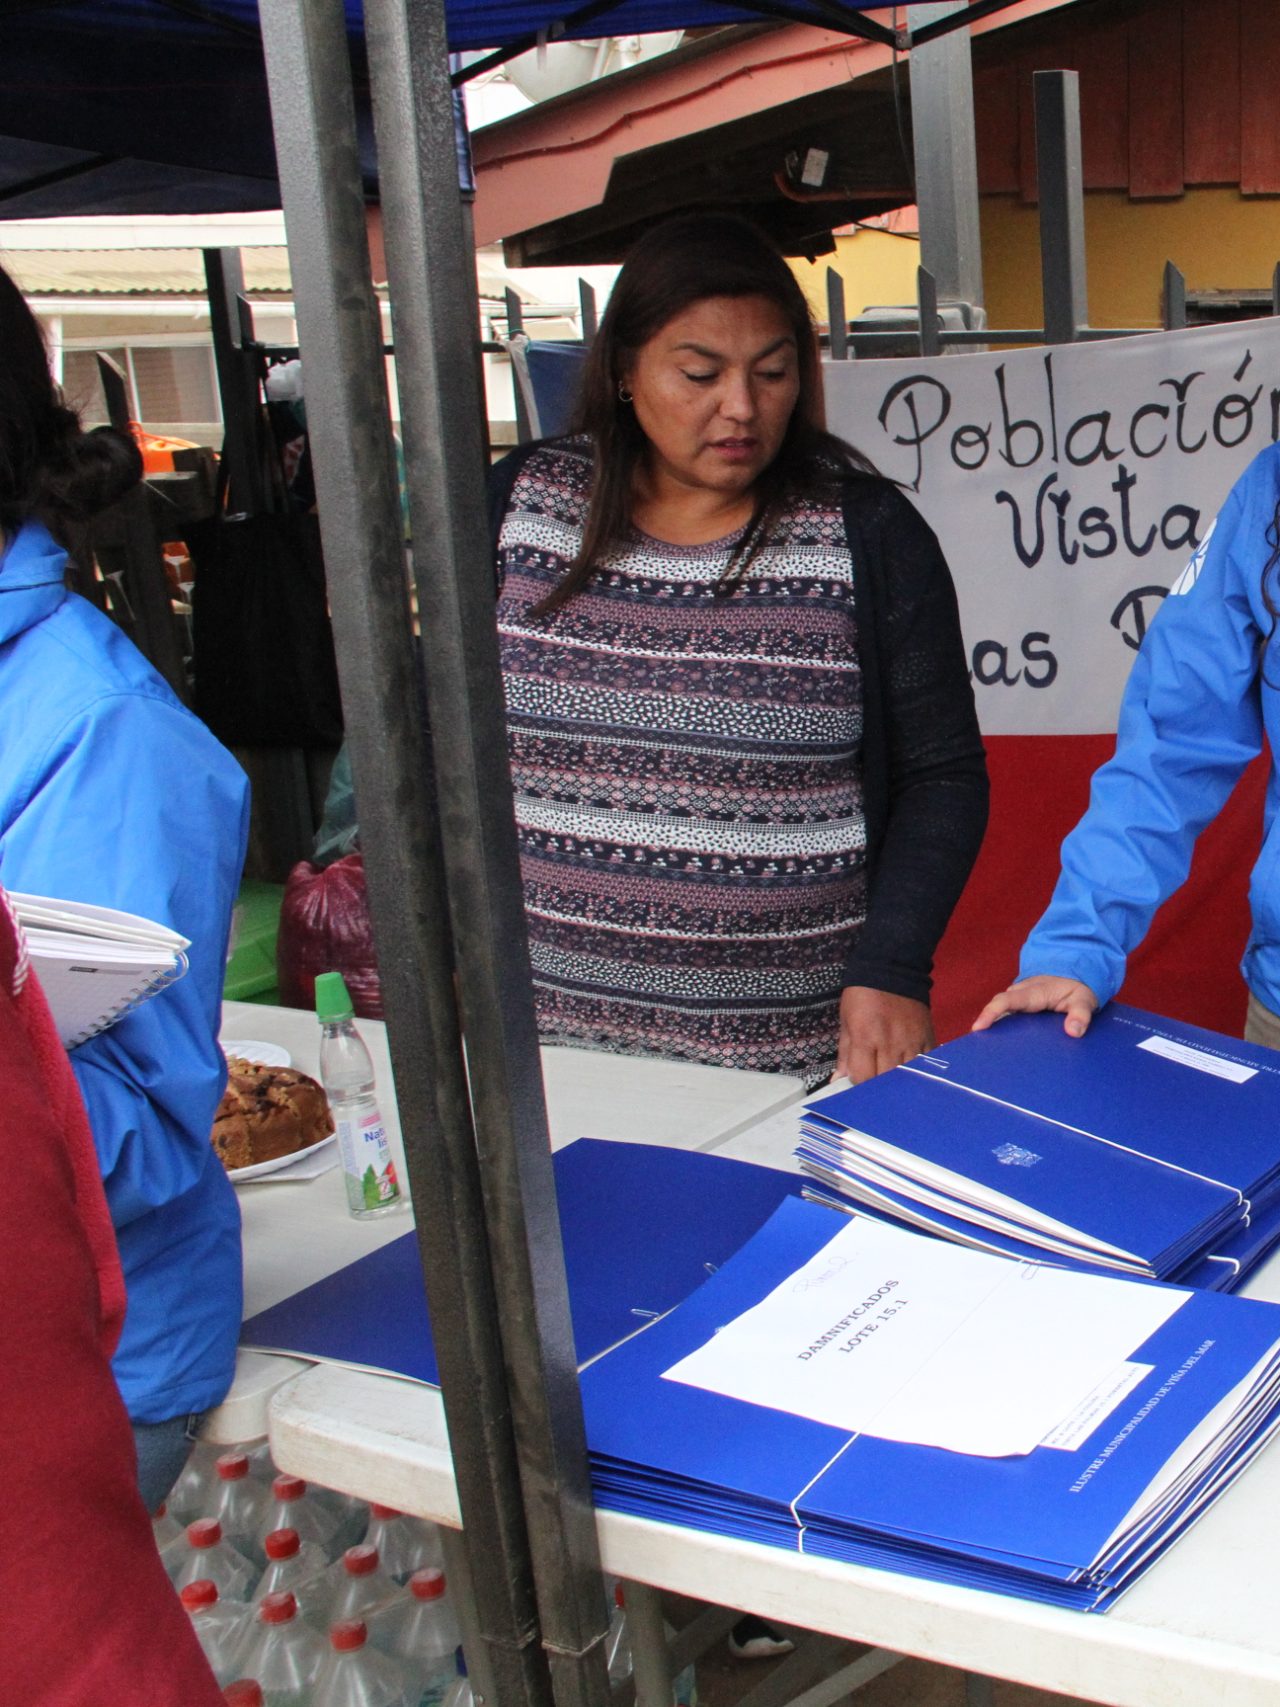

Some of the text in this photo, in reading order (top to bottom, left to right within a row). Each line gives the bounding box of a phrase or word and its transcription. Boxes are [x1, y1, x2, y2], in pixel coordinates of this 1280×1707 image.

[995, 464, 1201, 568] Vista
[968, 632, 1058, 689] as
[797, 1279, 899, 1360] DAMNIFICADOS
[838, 1299, 909, 1353] LOTE 15.1
[1069, 1339, 1216, 1493] ILUSTRE MUNICIPALIDAD DE VIÑA DEL MAR
